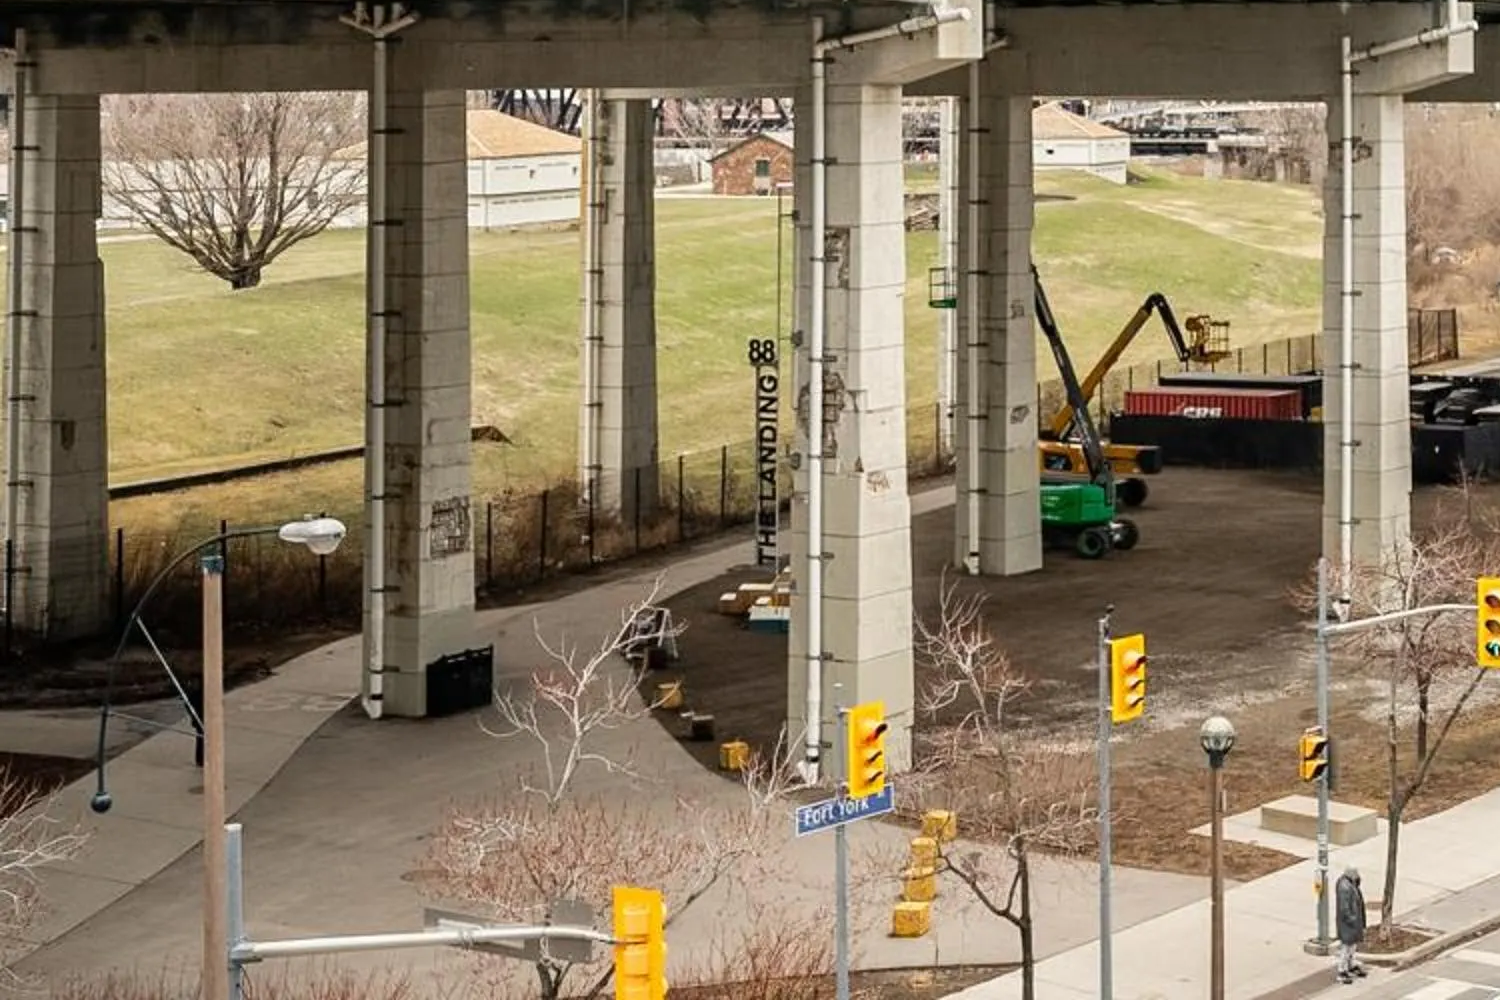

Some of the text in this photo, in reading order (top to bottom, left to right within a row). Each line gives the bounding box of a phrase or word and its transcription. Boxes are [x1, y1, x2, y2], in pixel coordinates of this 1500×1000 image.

[749, 339, 774, 362] 88
[758, 375, 778, 565] THE LANDING
[804, 798, 869, 826] Fort York
